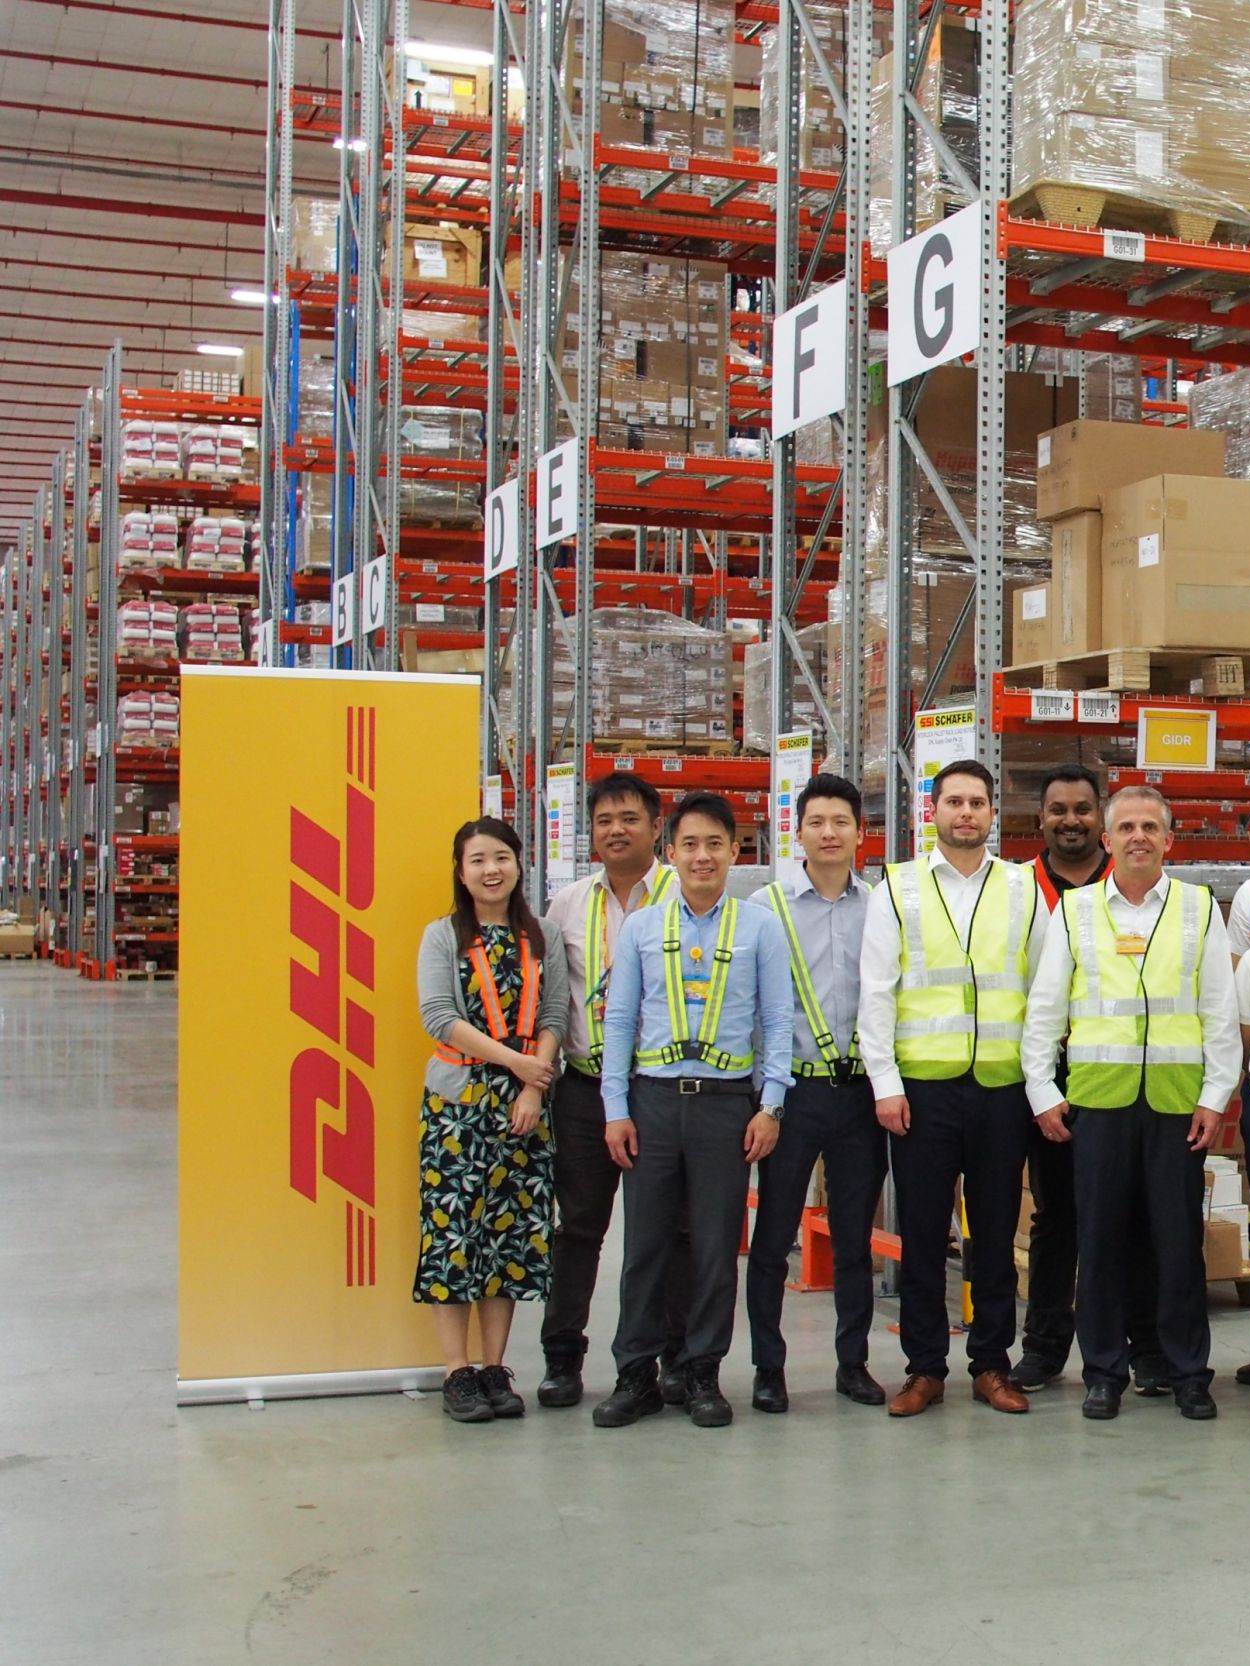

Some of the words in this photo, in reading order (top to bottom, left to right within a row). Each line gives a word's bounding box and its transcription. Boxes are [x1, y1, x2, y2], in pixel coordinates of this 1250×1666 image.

[914, 233, 953, 358] G
[793, 305, 818, 420] F
[546, 453, 564, 535] E
[492, 495, 506, 566] D
[338, 583, 346, 639] B
[370, 565, 379, 625] C
[262, 626, 268, 667] A
[1038, 707, 1061, 716] G01-11
[1084, 708, 1108, 718] G01-21
[1162, 734, 1192, 746] GIDR
[289, 782, 376, 1209] DHL
